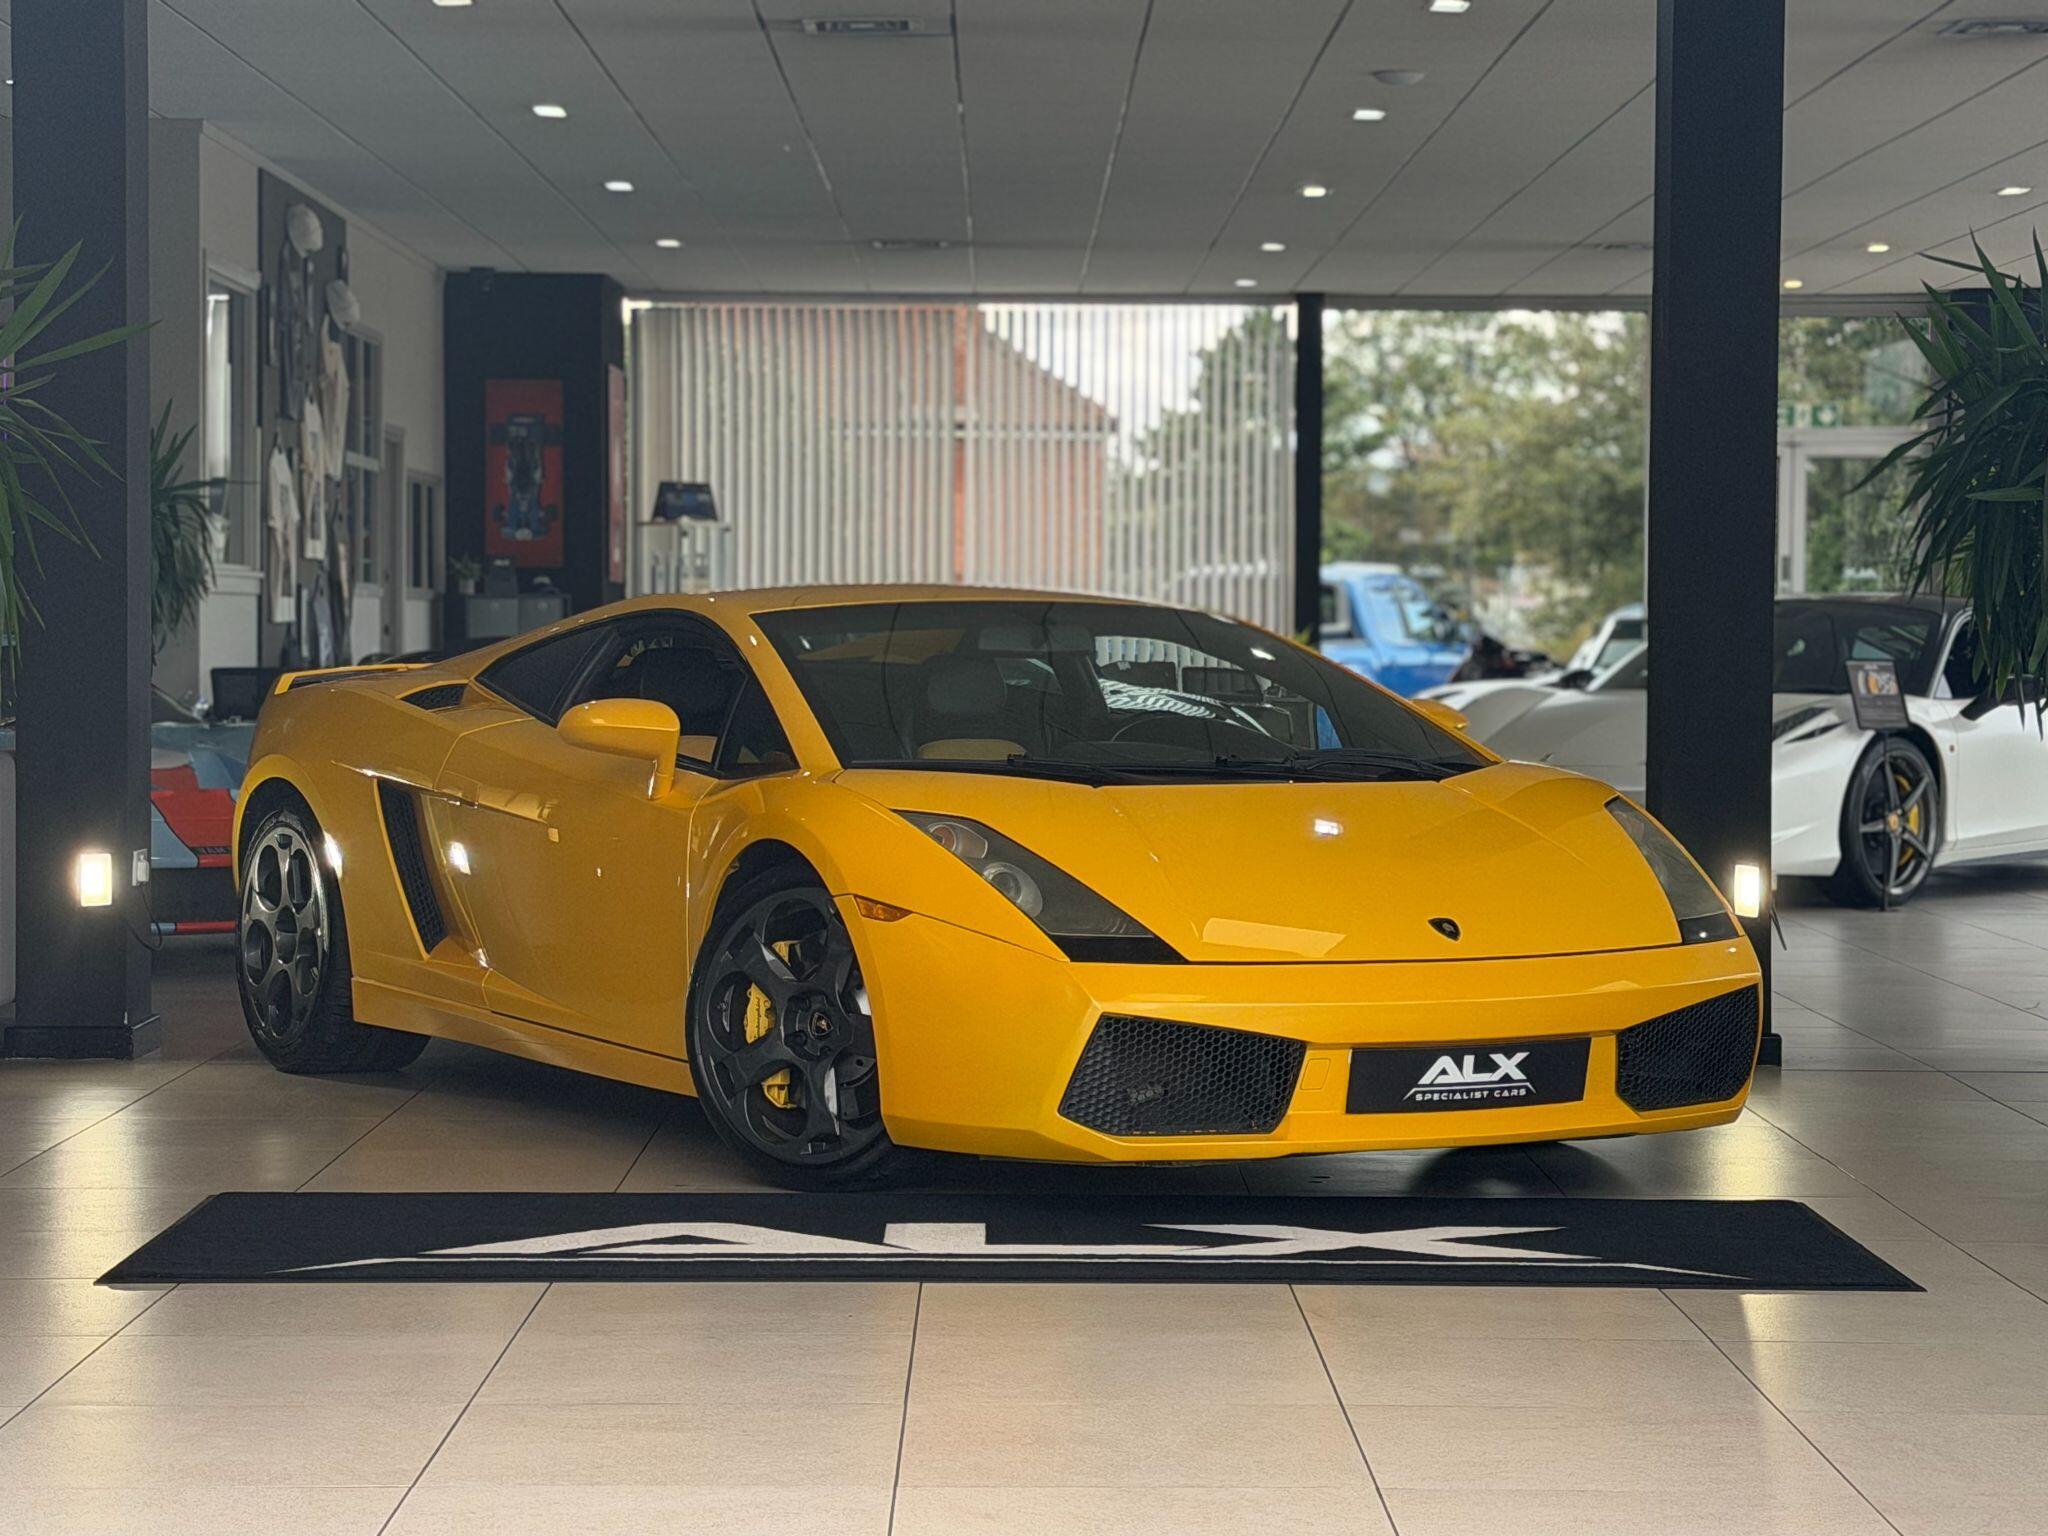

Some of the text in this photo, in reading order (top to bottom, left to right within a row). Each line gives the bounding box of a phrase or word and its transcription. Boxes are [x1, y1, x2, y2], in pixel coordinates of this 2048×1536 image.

[1416, 1051, 1531, 1085] ALX
[1415, 1088, 1527, 1101] SPECIALIST CARS
[416, 1221, 1603, 1259] ALX
